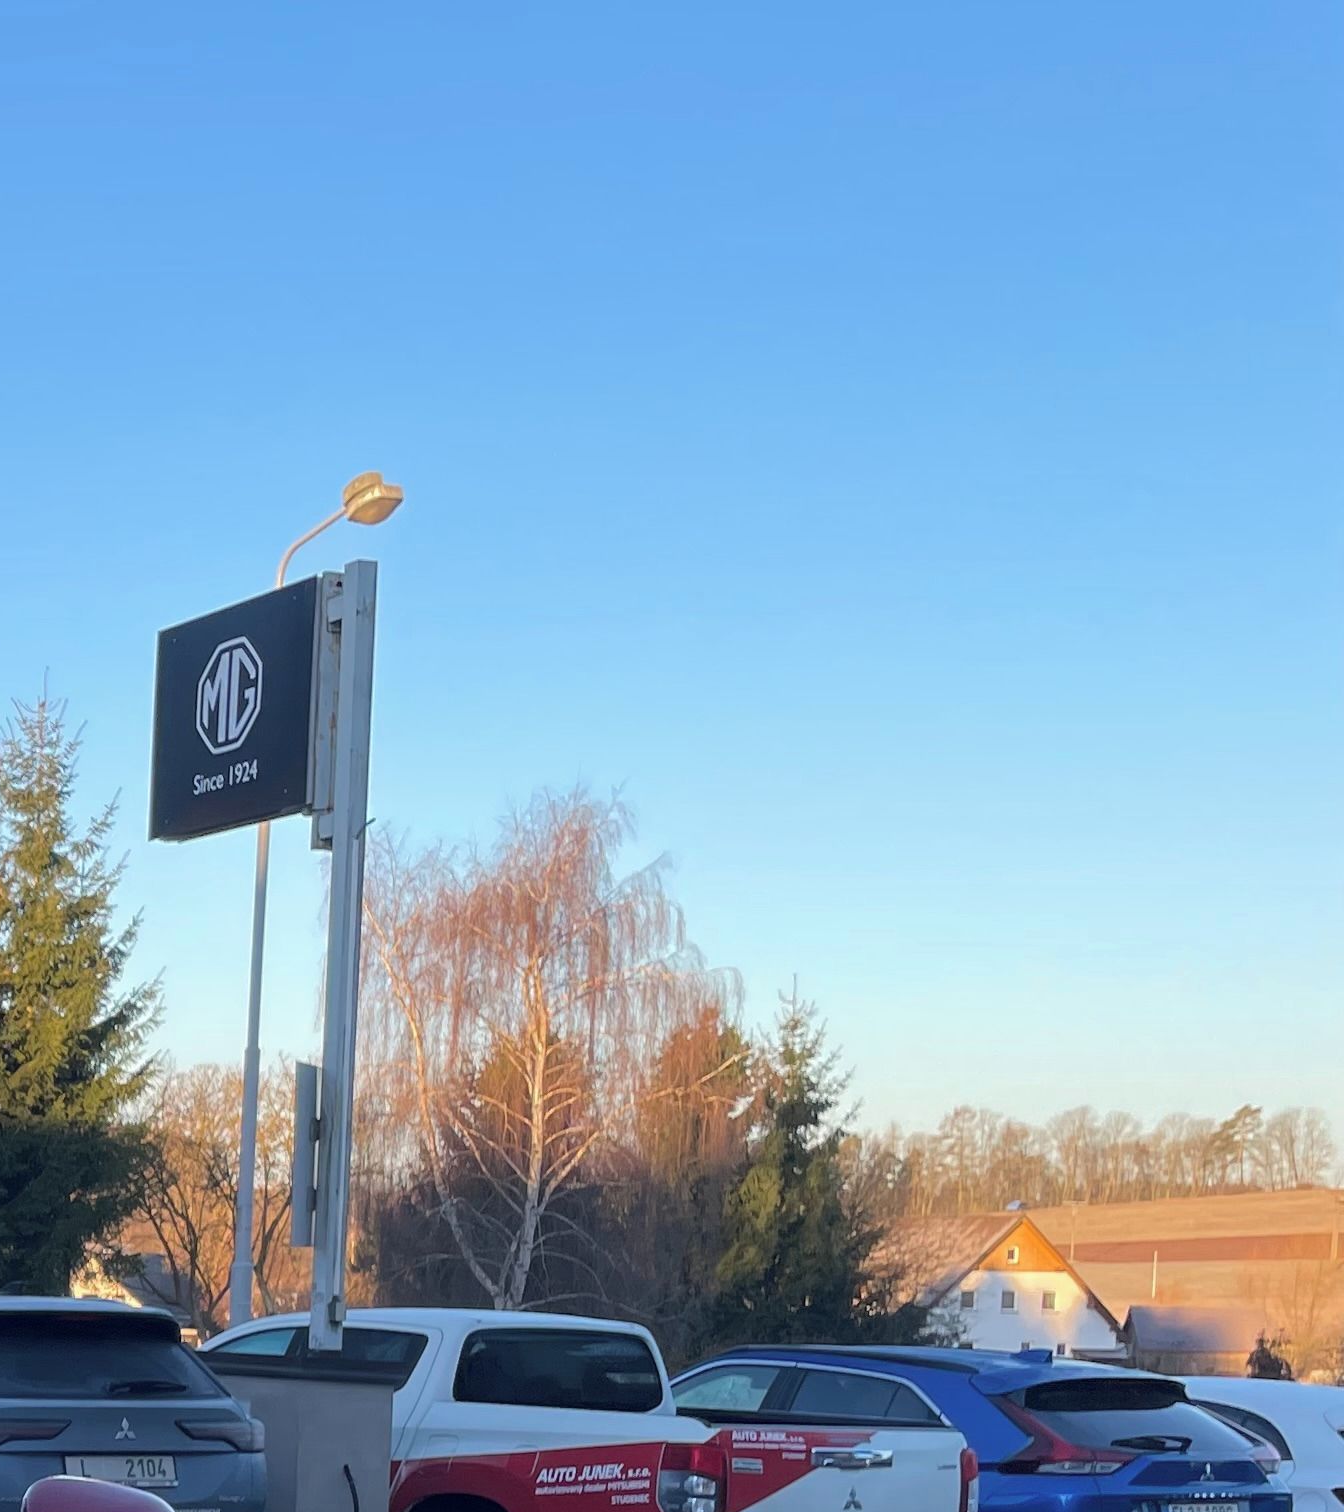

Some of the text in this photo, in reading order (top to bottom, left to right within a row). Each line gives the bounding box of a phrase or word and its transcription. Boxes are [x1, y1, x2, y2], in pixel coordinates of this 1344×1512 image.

[200, 645, 258, 745] MG
[192, 759, 258, 796] Since 1924
[126, 1459, 166, 1477] 2104
[536, 1467, 576, 1483] AUTO
